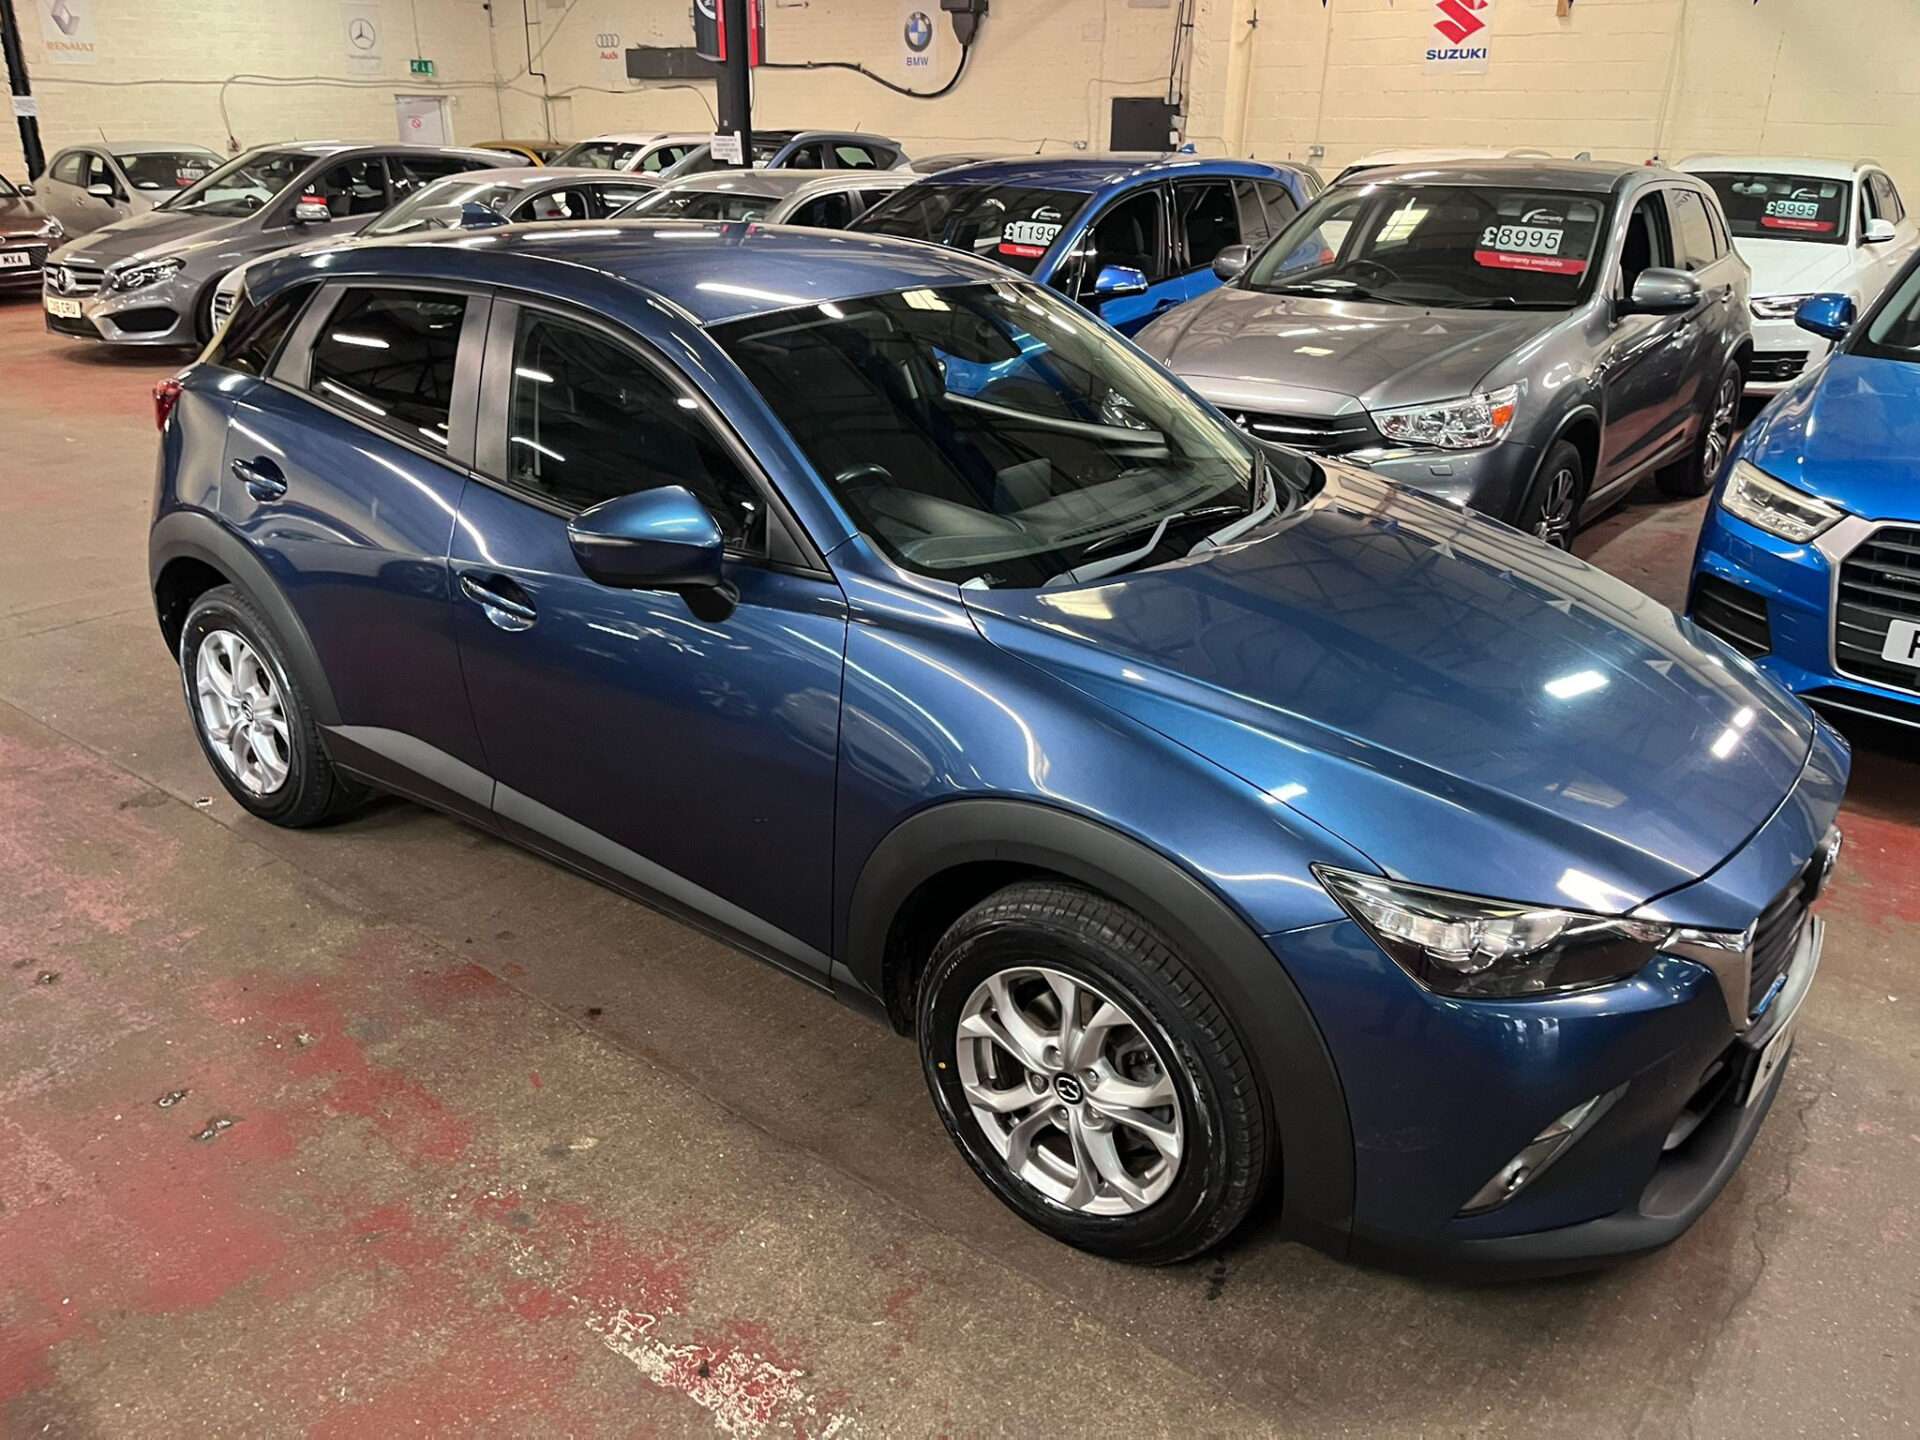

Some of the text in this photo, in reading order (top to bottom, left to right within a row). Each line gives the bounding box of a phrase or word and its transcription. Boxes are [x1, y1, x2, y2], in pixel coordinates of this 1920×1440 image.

[46, 41, 94, 51] RENAULT
[1426, 47, 1487, 60] SUZUKI
[906, 56, 928, 66] BMW
[1481, 226, 1560, 250] £8995
